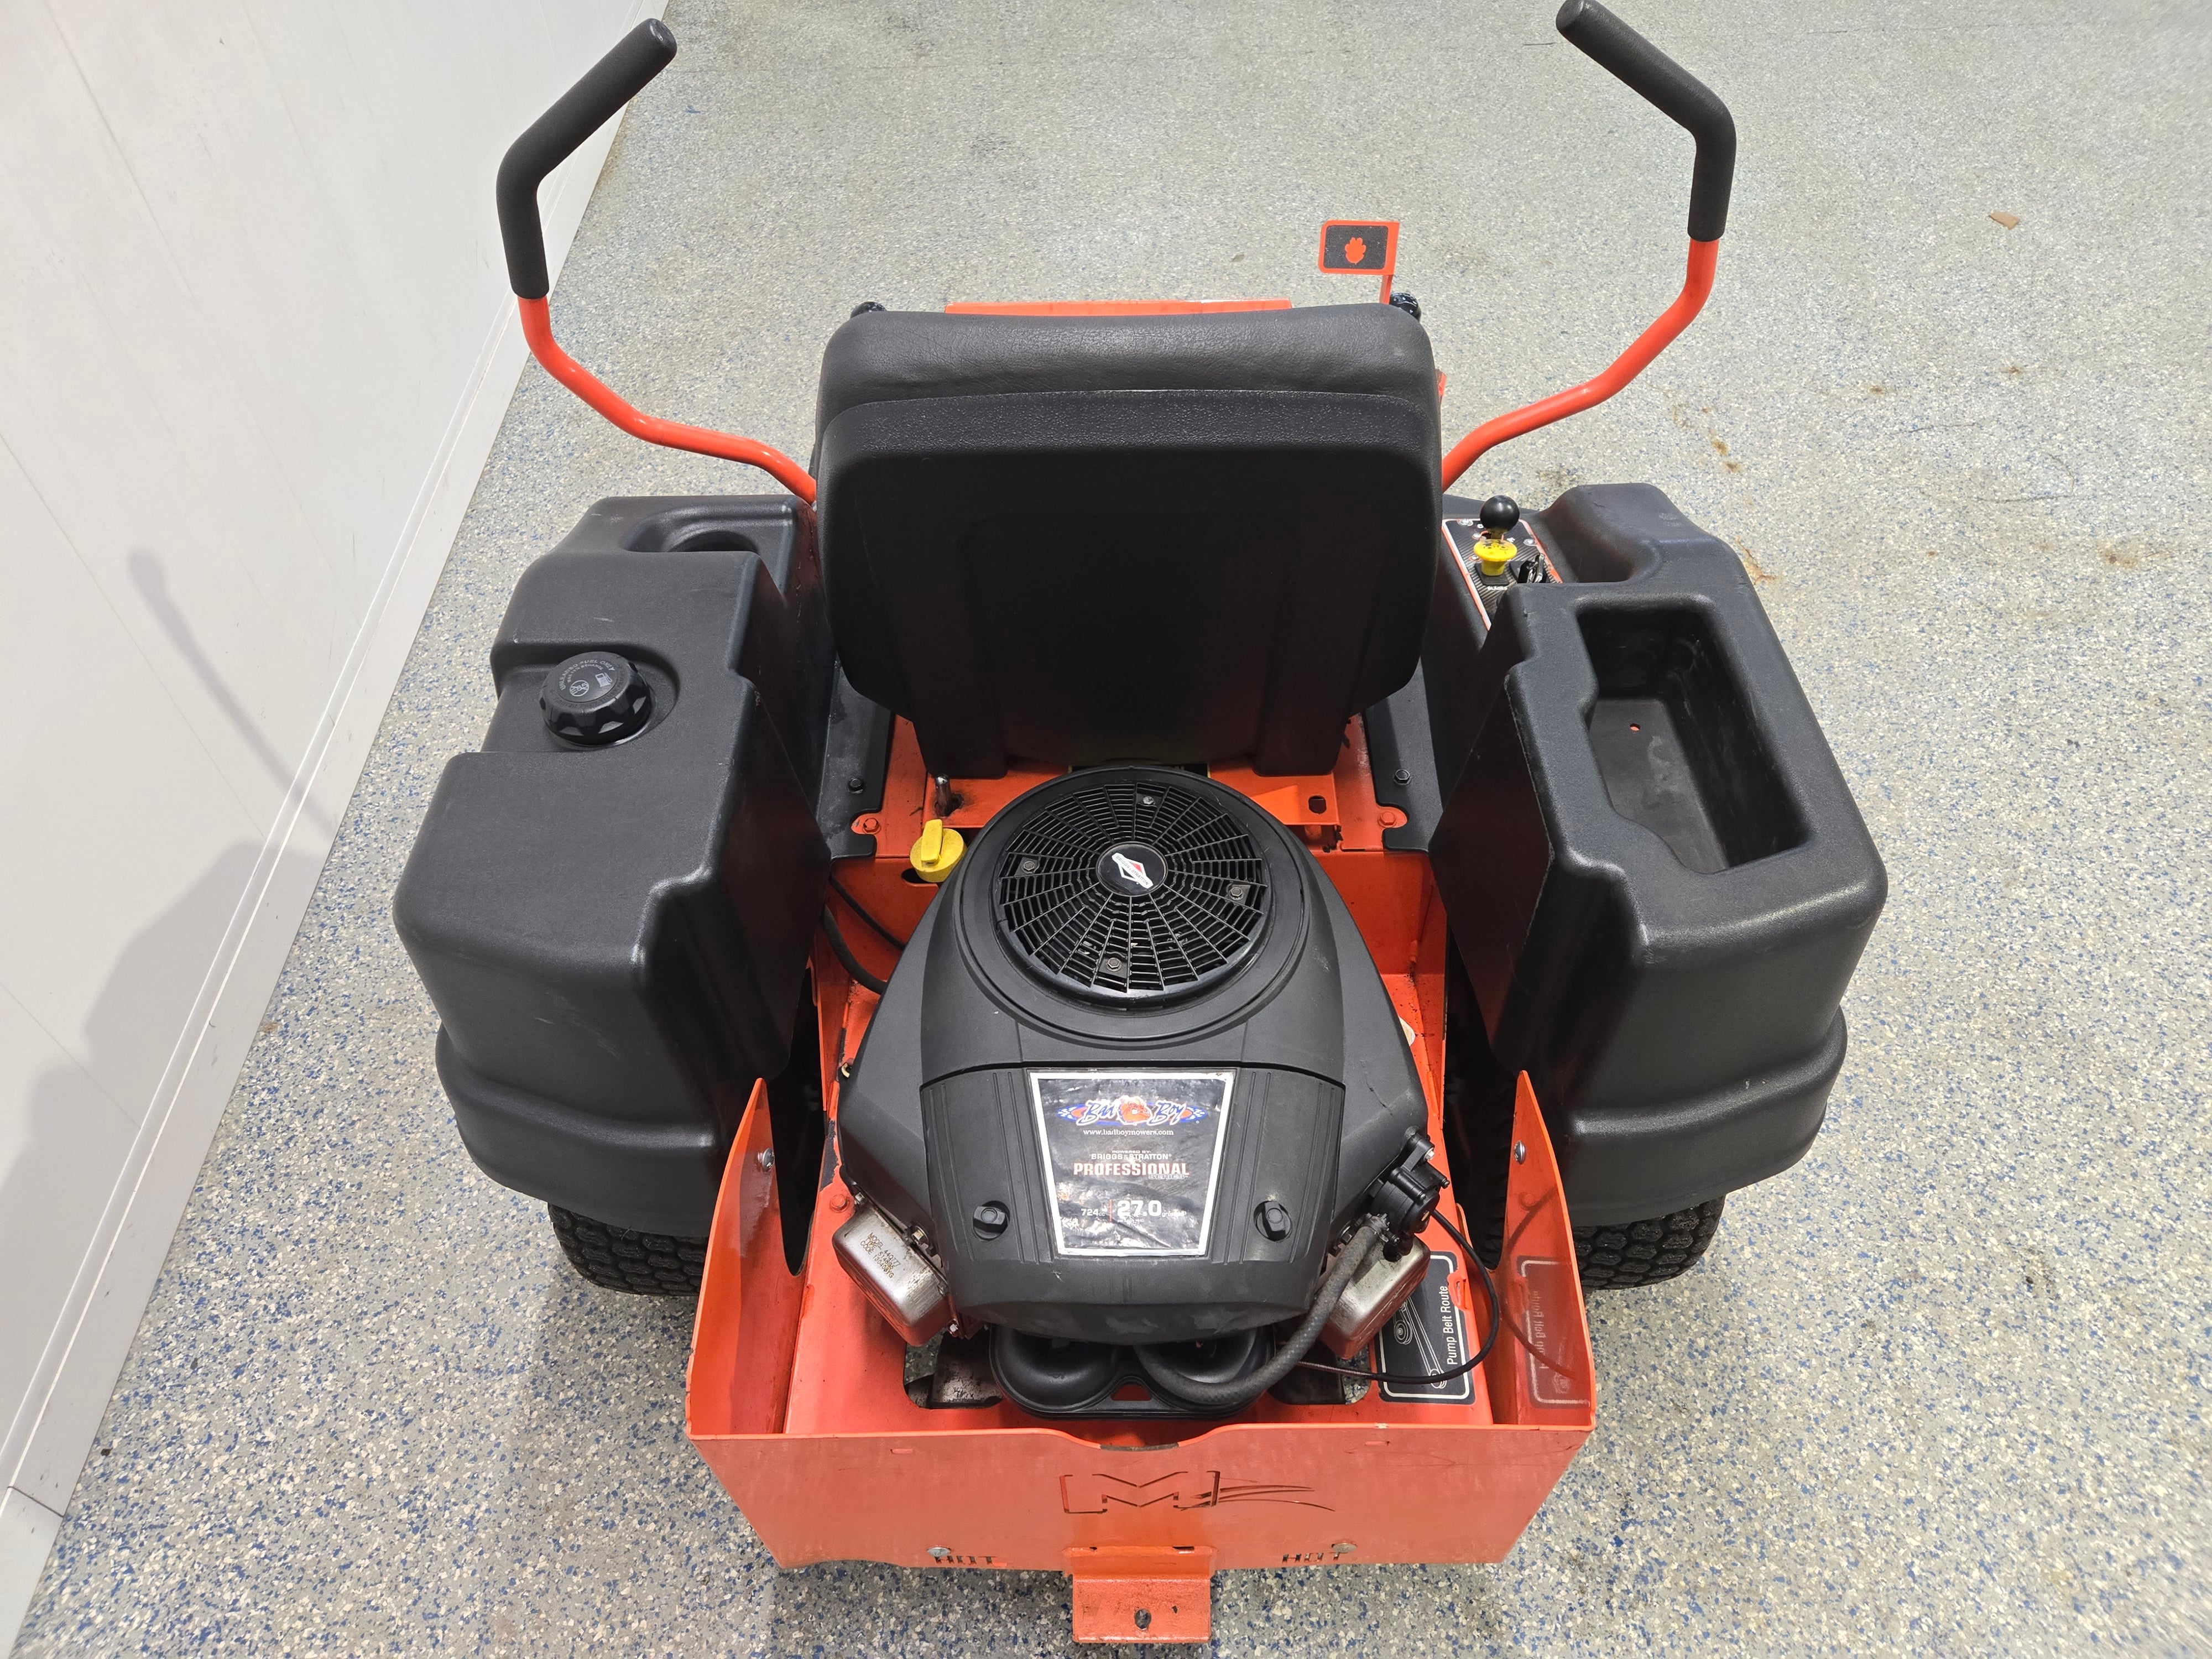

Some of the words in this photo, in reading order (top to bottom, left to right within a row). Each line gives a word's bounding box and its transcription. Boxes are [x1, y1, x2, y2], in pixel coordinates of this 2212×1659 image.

[599, 660, 615, 671] ONLY
[1146, 1100, 1187, 1126] Boy
[1073, 1162, 1190, 1176] PROFESSIONAL
[1117, 1200, 1161, 1217] 27.0
[860, 1241, 874, 1255] CODE
[868, 1232, 883, 1250] MODEL
[1439, 1286, 1451, 1313] Route
[1442, 1315, 1454, 1334] Belt
[1447, 1337, 1458, 1365] Pump
